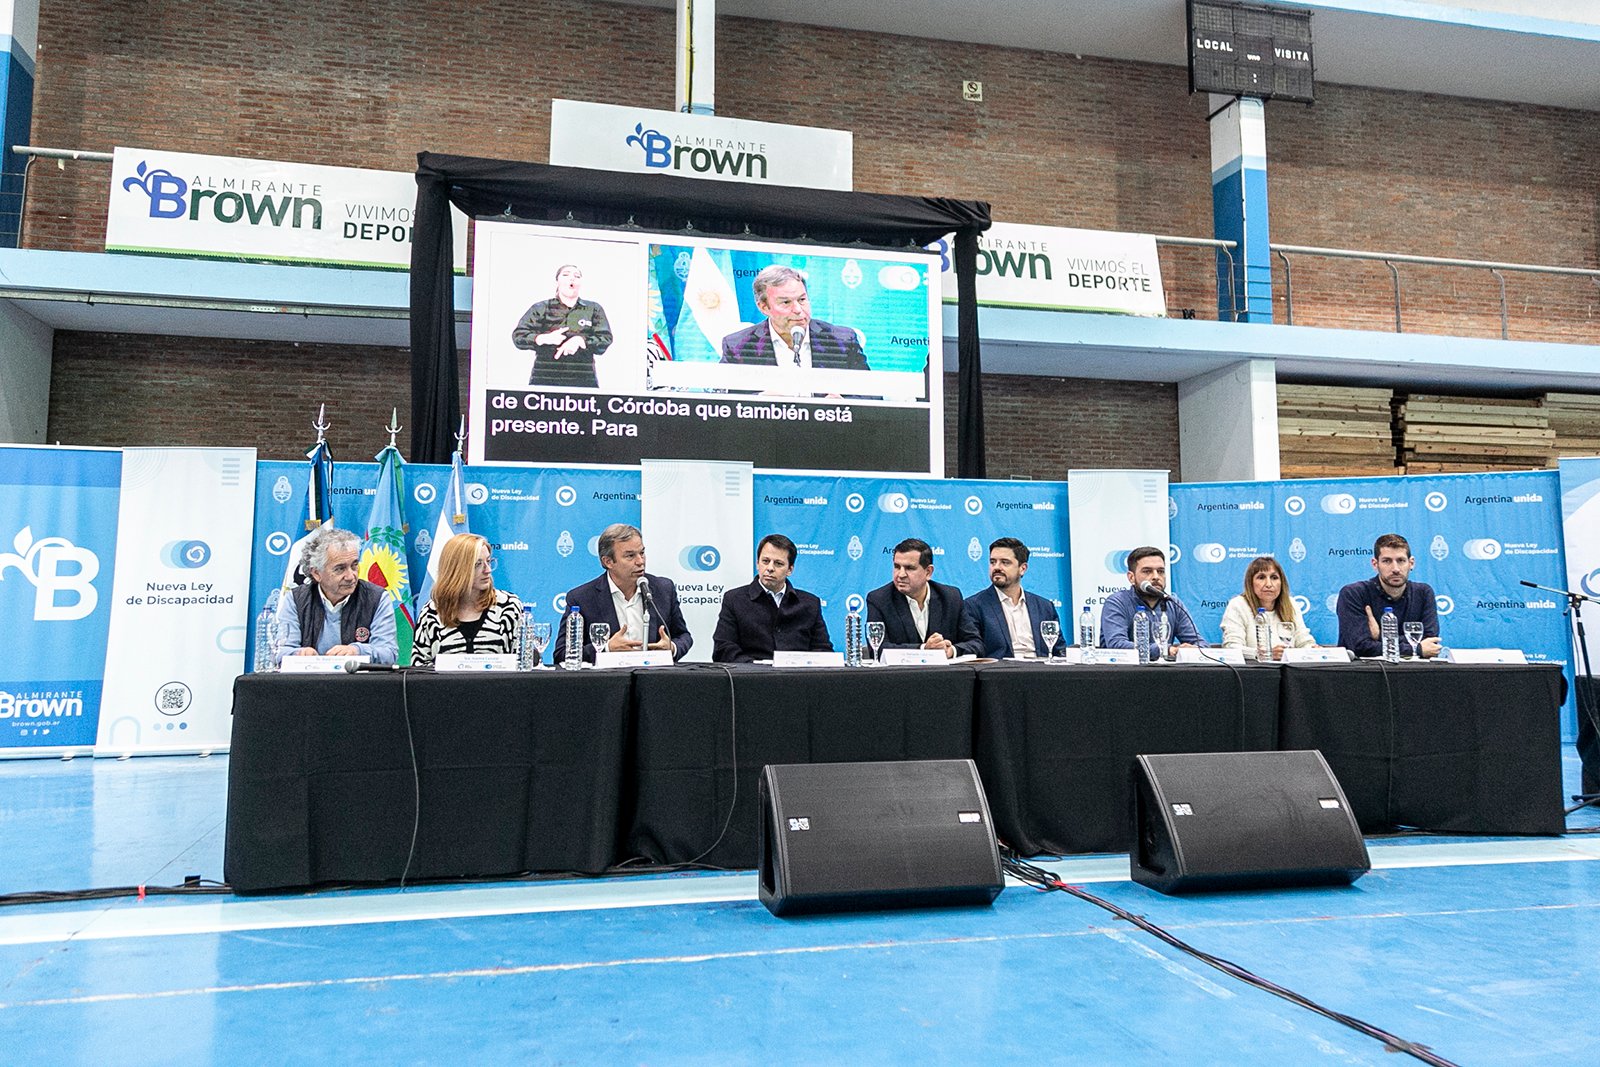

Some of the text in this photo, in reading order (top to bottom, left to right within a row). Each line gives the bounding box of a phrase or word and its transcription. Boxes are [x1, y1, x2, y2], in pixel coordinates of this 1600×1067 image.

[1196, 38, 1233, 52] LOCAL
[1274, 47, 1309, 61] VISITA
[674, 134, 766, 153] ALMIRANTE
[645, 133, 767, 179] Brown
[191, 175, 322, 196] ALMIRANTE
[149, 174, 323, 230] Brown
[343, 222, 414, 243] DEPO
[1067, 257, 1149, 276] VIVIMOS EL
[1068, 273, 1152, 292] DEPORTE
[491, 392, 853, 423] de Chubut, Córdoba que también está
[490, 418, 638, 438] presente. Para
[500, 494, 540, 502] Discapacidad
[593, 491, 636, 501] Argentina
[1378, 496, 1390, 504] Ley
[1464, 494, 1543, 505] Argentina unida
[1197, 501, 1265, 512] Argentina unida
[502, 541, 529, 550] unida
[1328, 547, 1373, 557] Argentina
[146, 582, 213, 593] Nueva Ley
[706, 583, 725, 594] Ley
[126, 595, 234, 606] de Discapacidad
[1085, 597, 1097, 605] de
[1476, 599, 1556, 611] Argentina unida
[16, 690, 83, 699] ALMIRANTE
[0, 692, 83, 719] Brown
